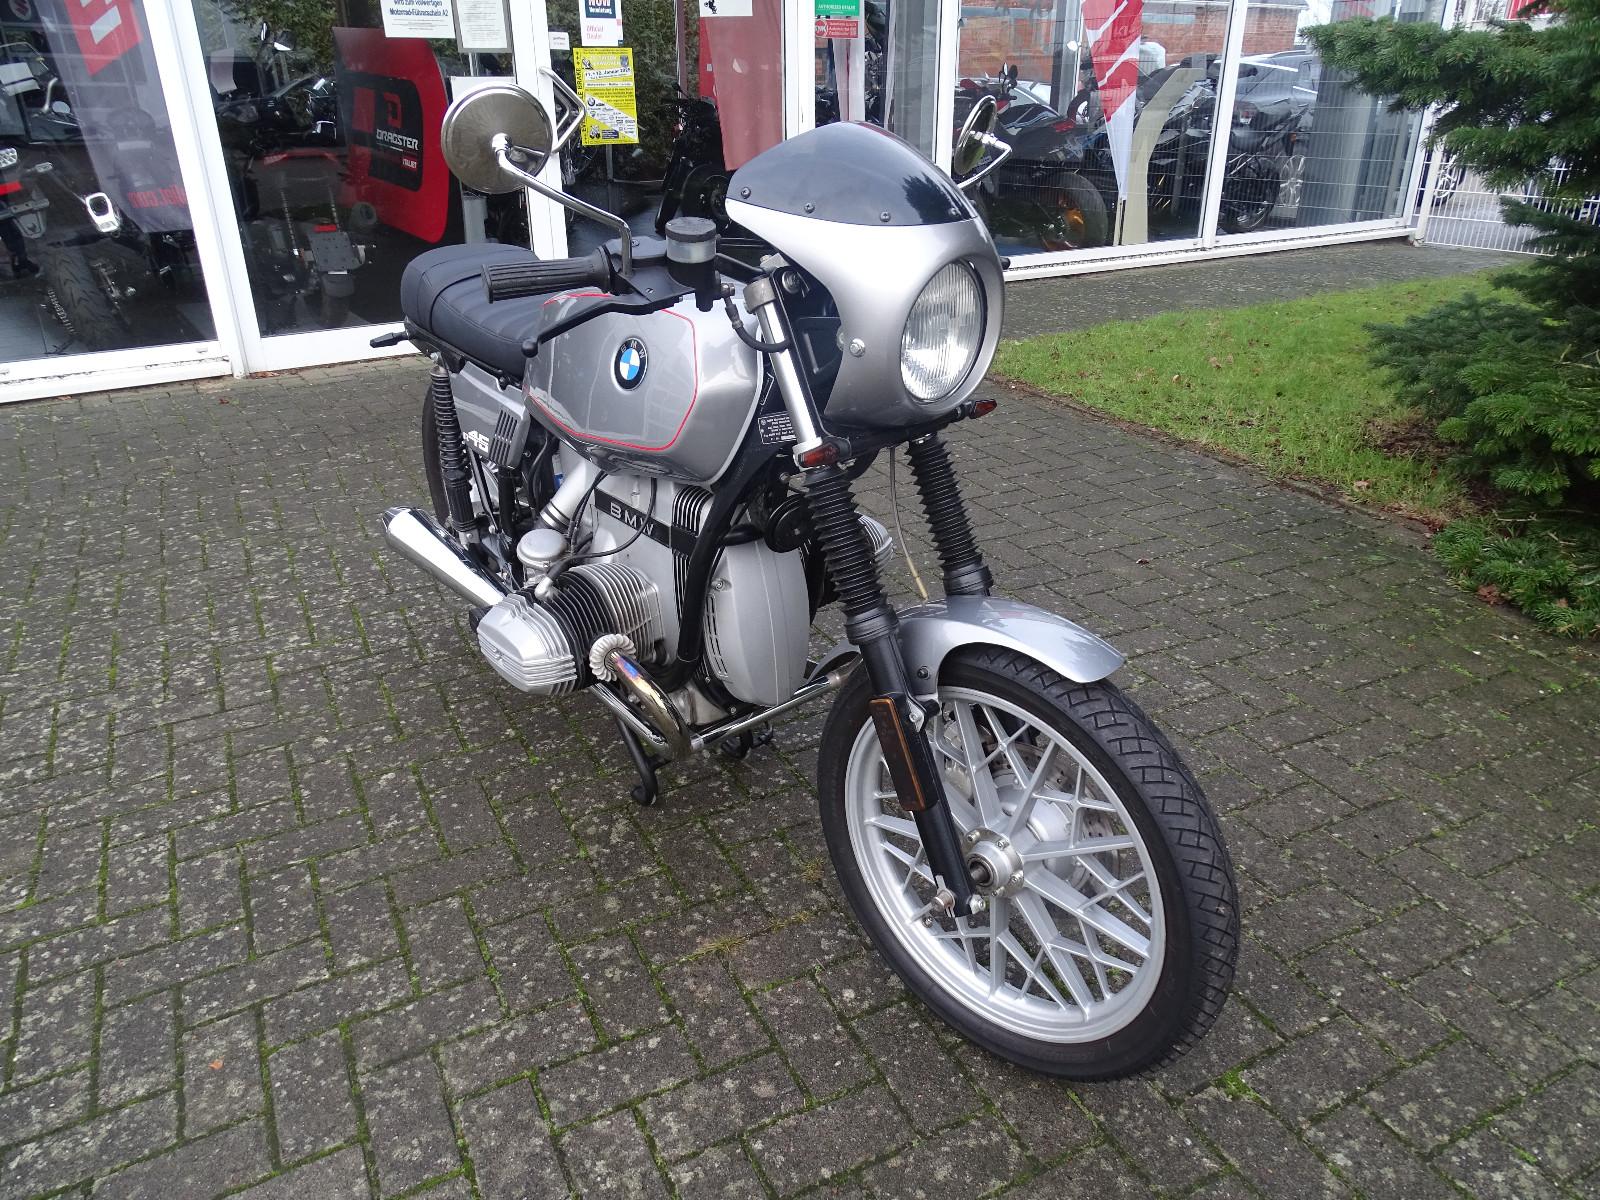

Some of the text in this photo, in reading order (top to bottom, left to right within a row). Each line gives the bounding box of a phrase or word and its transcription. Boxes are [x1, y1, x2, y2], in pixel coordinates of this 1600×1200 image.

[376, 129, 419, 151] DRAGSTER
[620, 339, 646, 359] BMW
[610, 501, 654, 536] BMW
